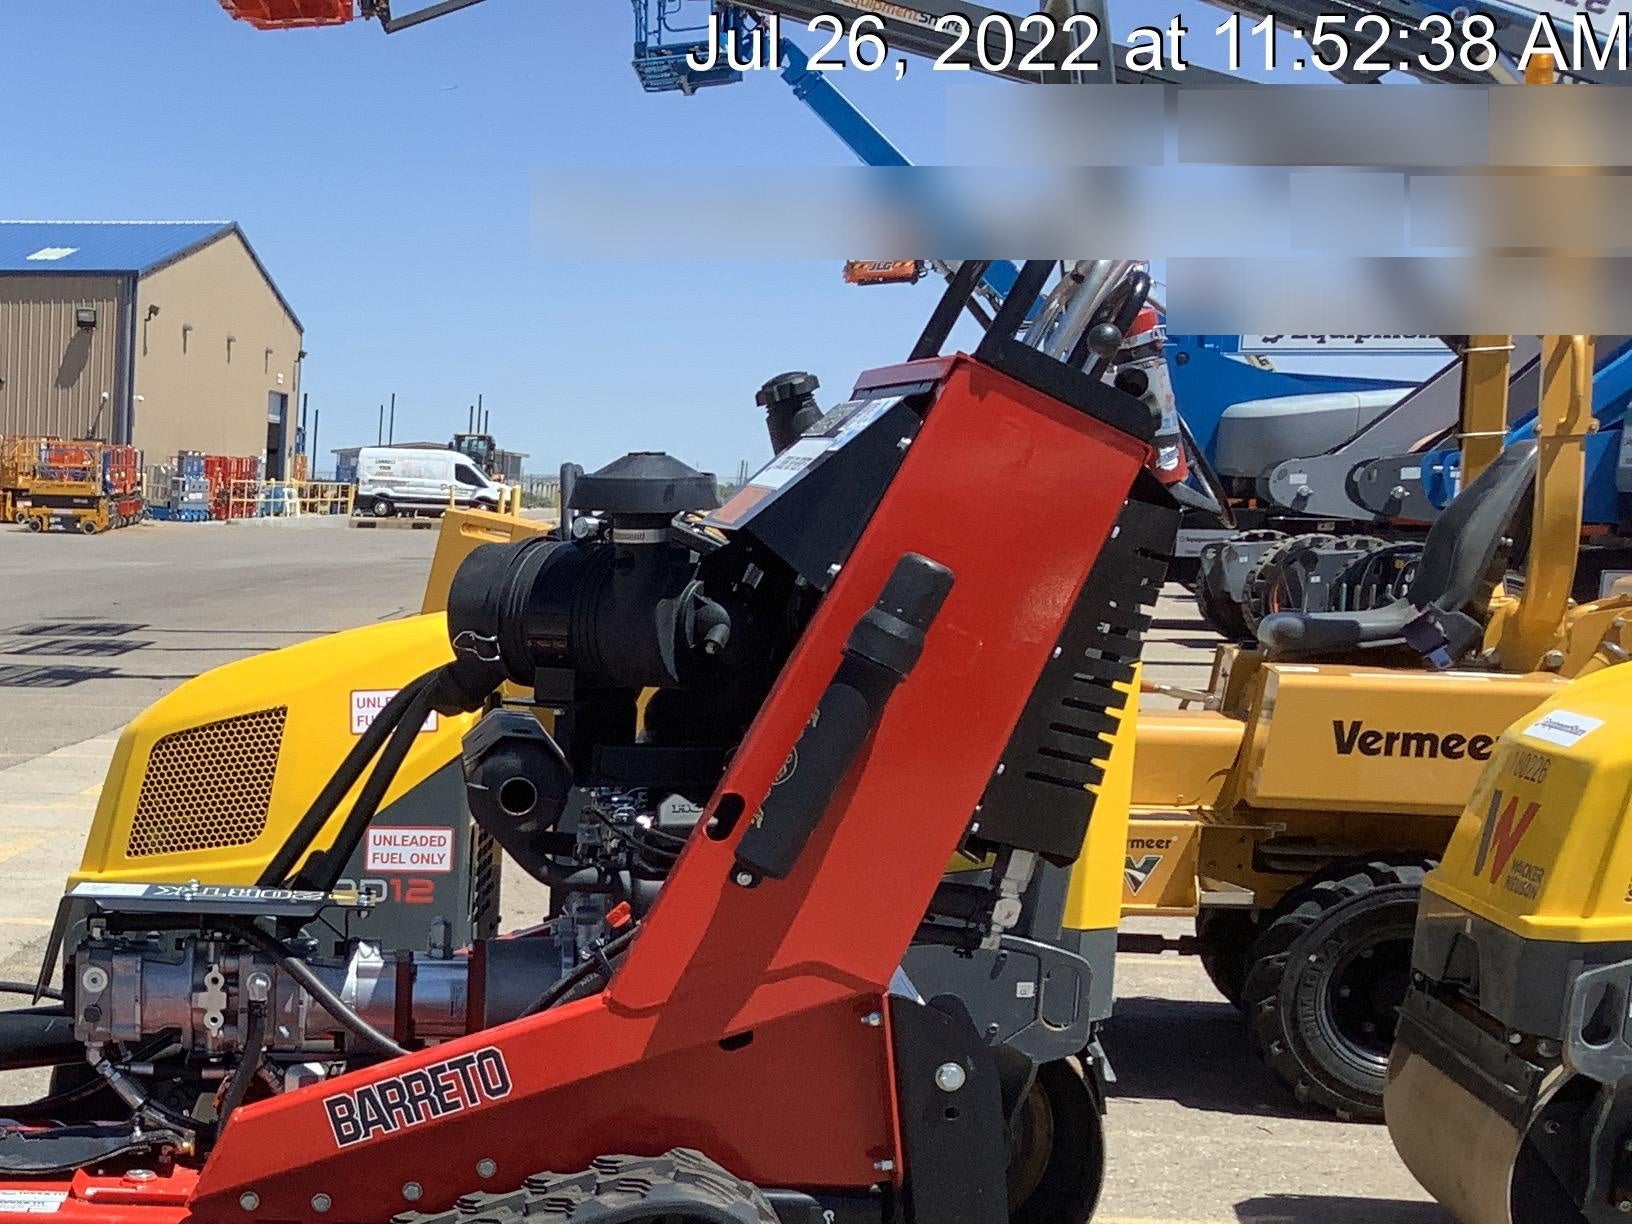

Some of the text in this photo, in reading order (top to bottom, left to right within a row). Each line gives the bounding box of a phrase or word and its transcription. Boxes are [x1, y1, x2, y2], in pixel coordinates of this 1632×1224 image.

[1333, 720, 1499, 760] Vermee
[372, 835, 447, 847] UNLEADED
[372, 852, 447, 865] FUEL ONLY
[322, 1045, 512, 1149] BARRETO
